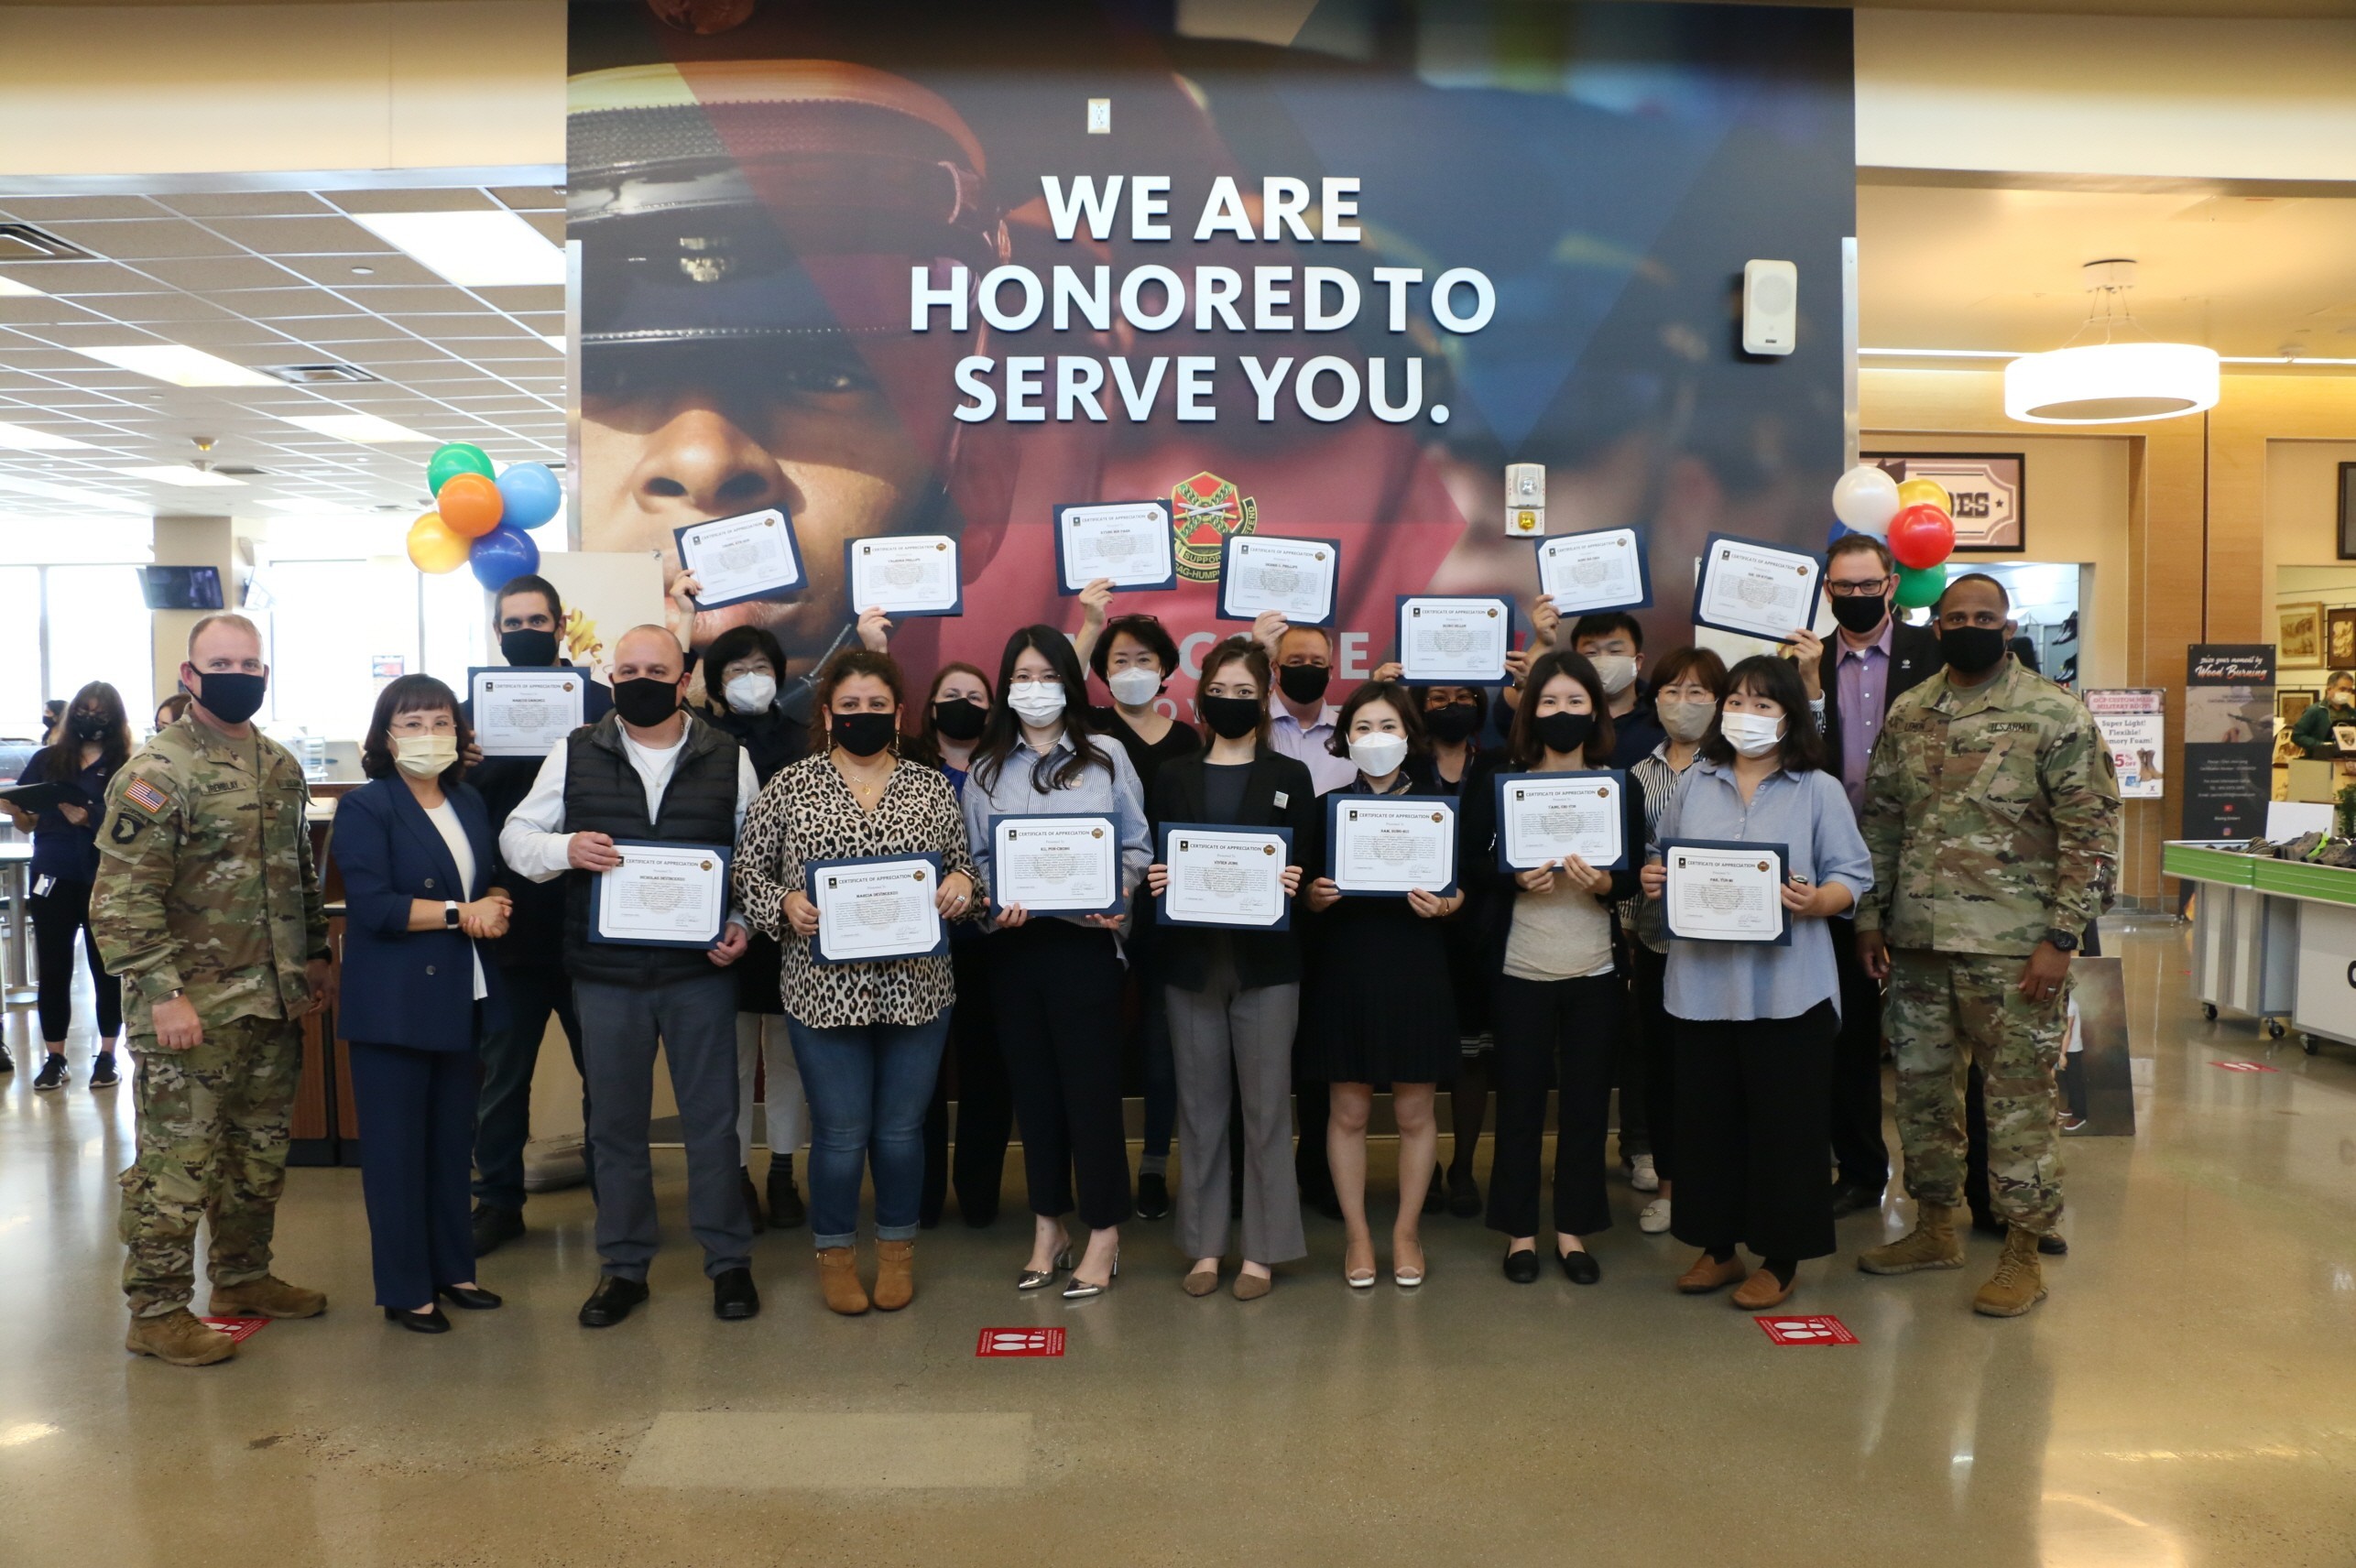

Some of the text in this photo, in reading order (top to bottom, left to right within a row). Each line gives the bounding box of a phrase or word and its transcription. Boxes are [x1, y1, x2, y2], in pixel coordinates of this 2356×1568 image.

[1041, 175, 1361, 242] WE ARE
[911, 264, 1497, 335] HONORED TO
[953, 354, 1450, 425] SERVE YOU.
[1183, 552, 1222, 564] SUPPOR
[2195, 664, 2268, 681] Wood Burning
[2124, 720, 2146, 728] Light!
